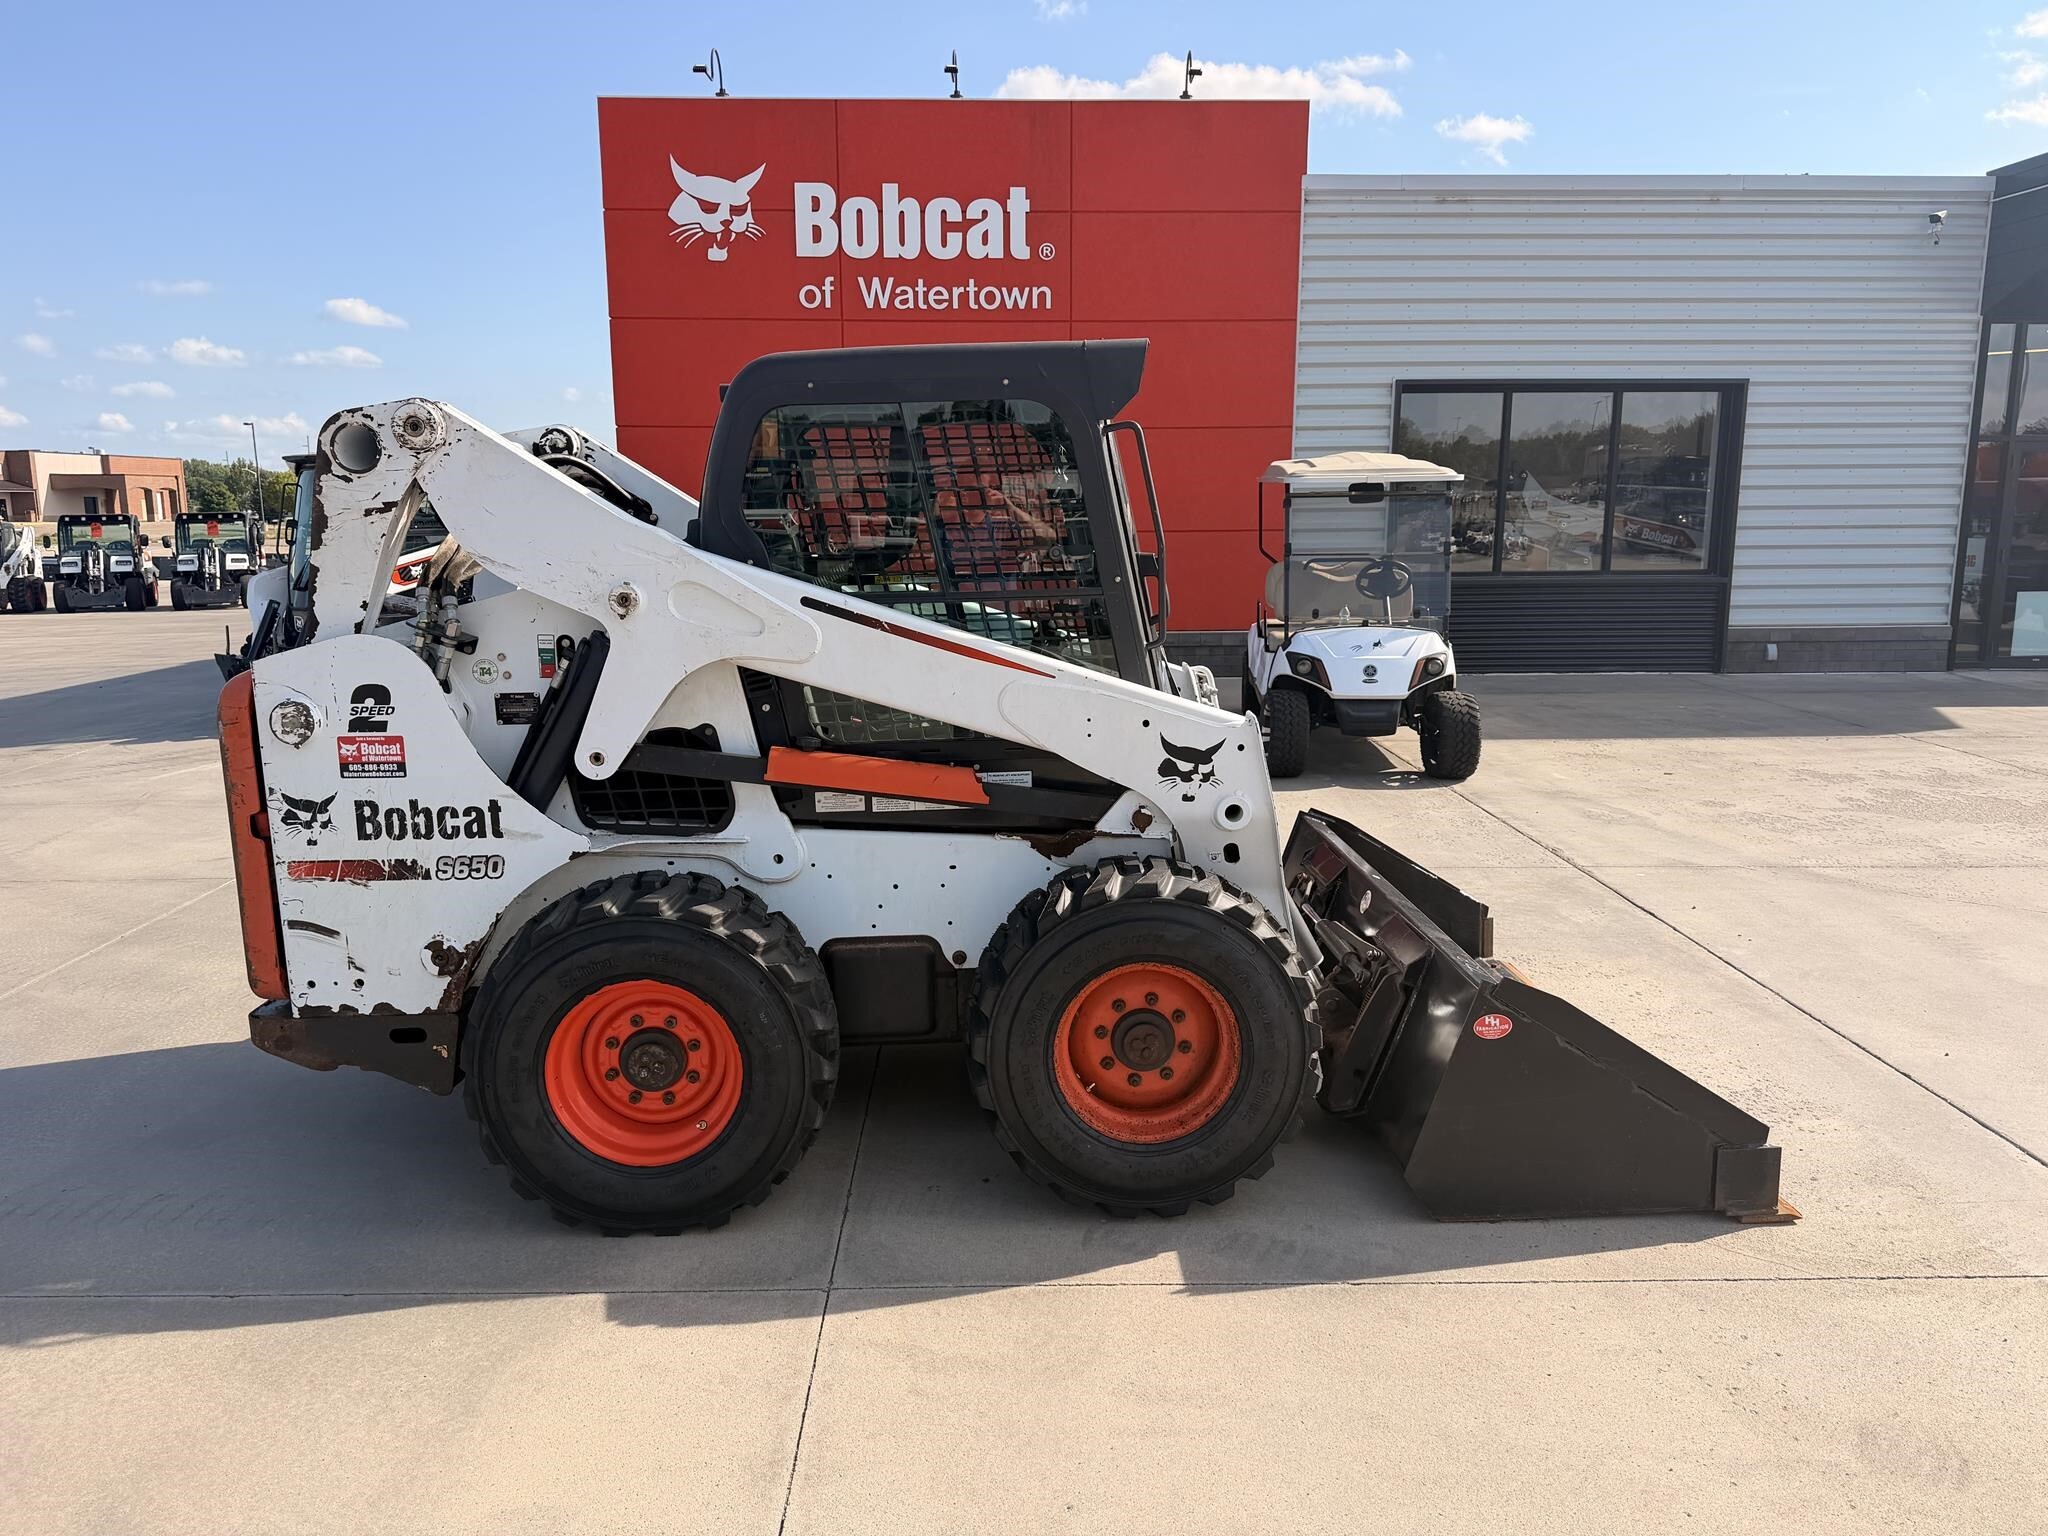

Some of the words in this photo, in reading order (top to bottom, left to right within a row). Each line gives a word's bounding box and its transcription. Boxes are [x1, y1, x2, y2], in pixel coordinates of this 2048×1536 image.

[794, 182, 1031, 260] Bobcat
[798, 276, 835, 309] of
[857, 276, 1052, 310] Watertown
[347, 683, 392, 732] 2
[349, 706, 396, 716] SPEED
[361, 742, 401, 754] Bobcat
[353, 799, 505, 841] Bobcat
[435, 855, 506, 881] S650
